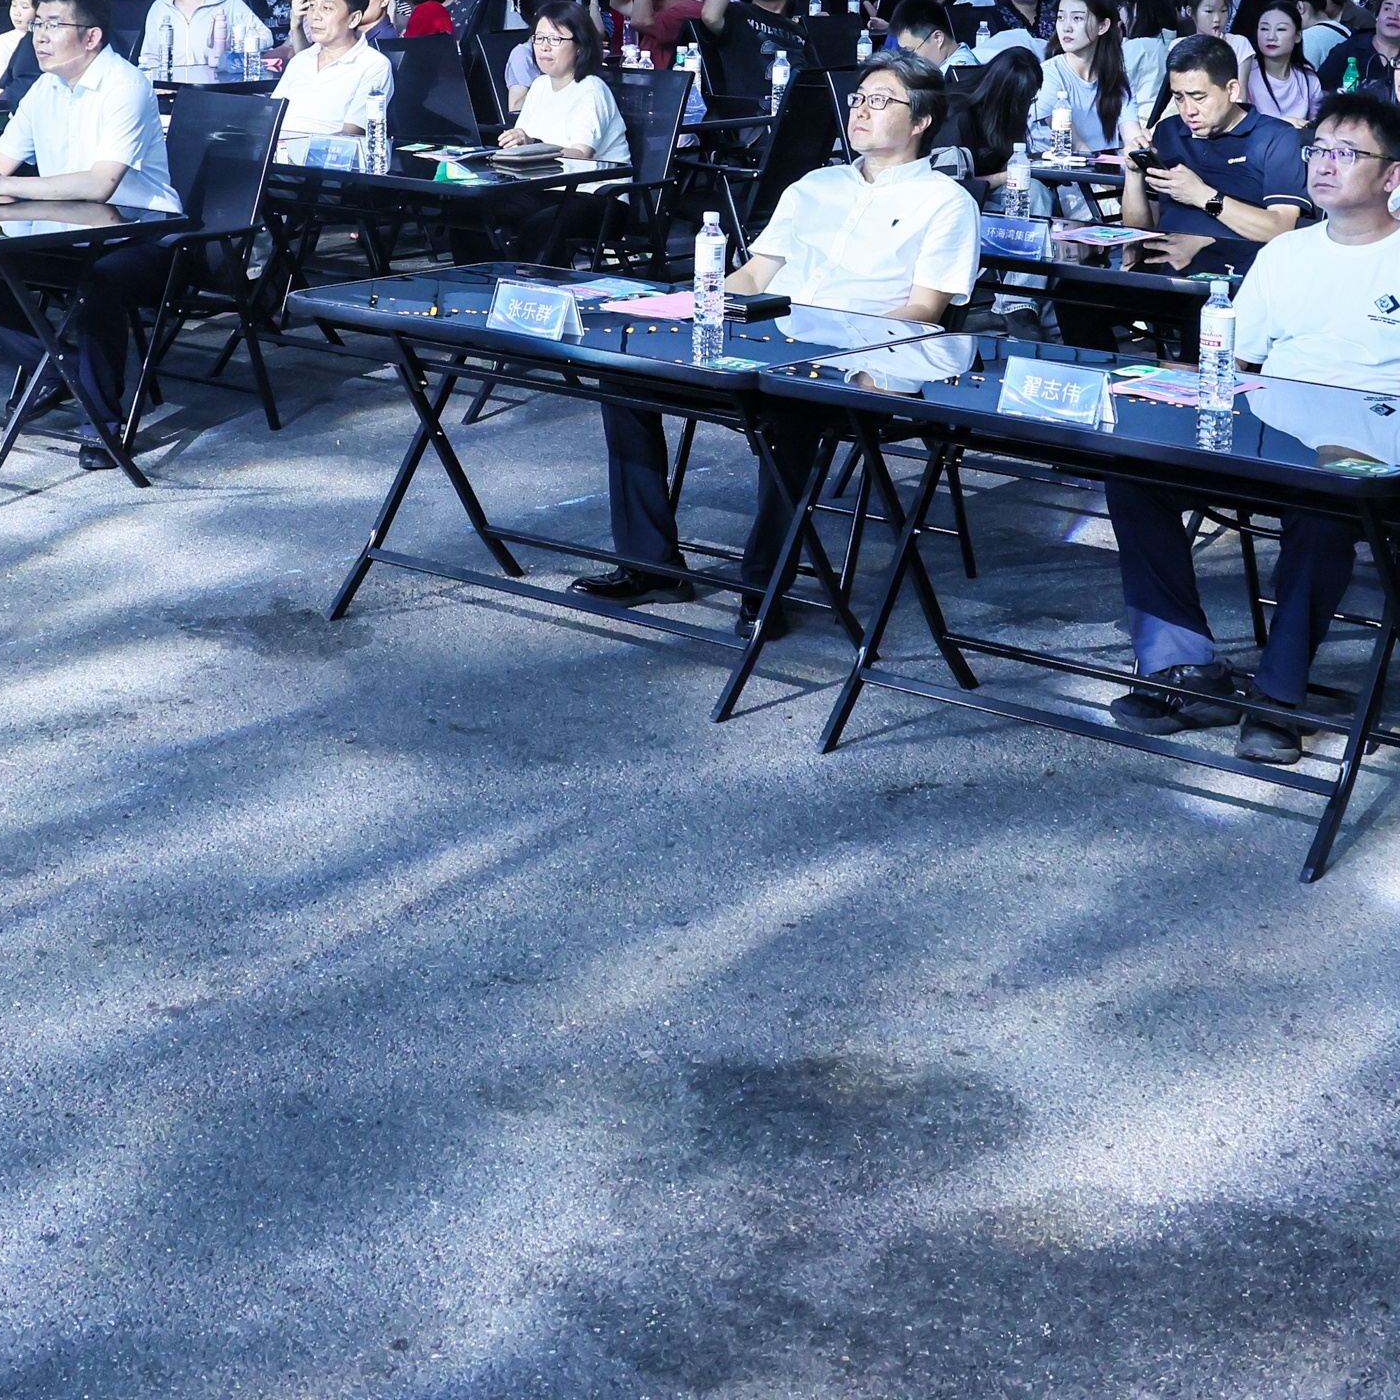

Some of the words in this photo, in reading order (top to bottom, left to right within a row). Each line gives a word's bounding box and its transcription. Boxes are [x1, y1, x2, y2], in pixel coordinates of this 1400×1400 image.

[986, 227, 1036, 243] 环海湾集团
[508, 298, 553, 323] 张乐群
[1022, 374, 1082, 404] 翟志伟
